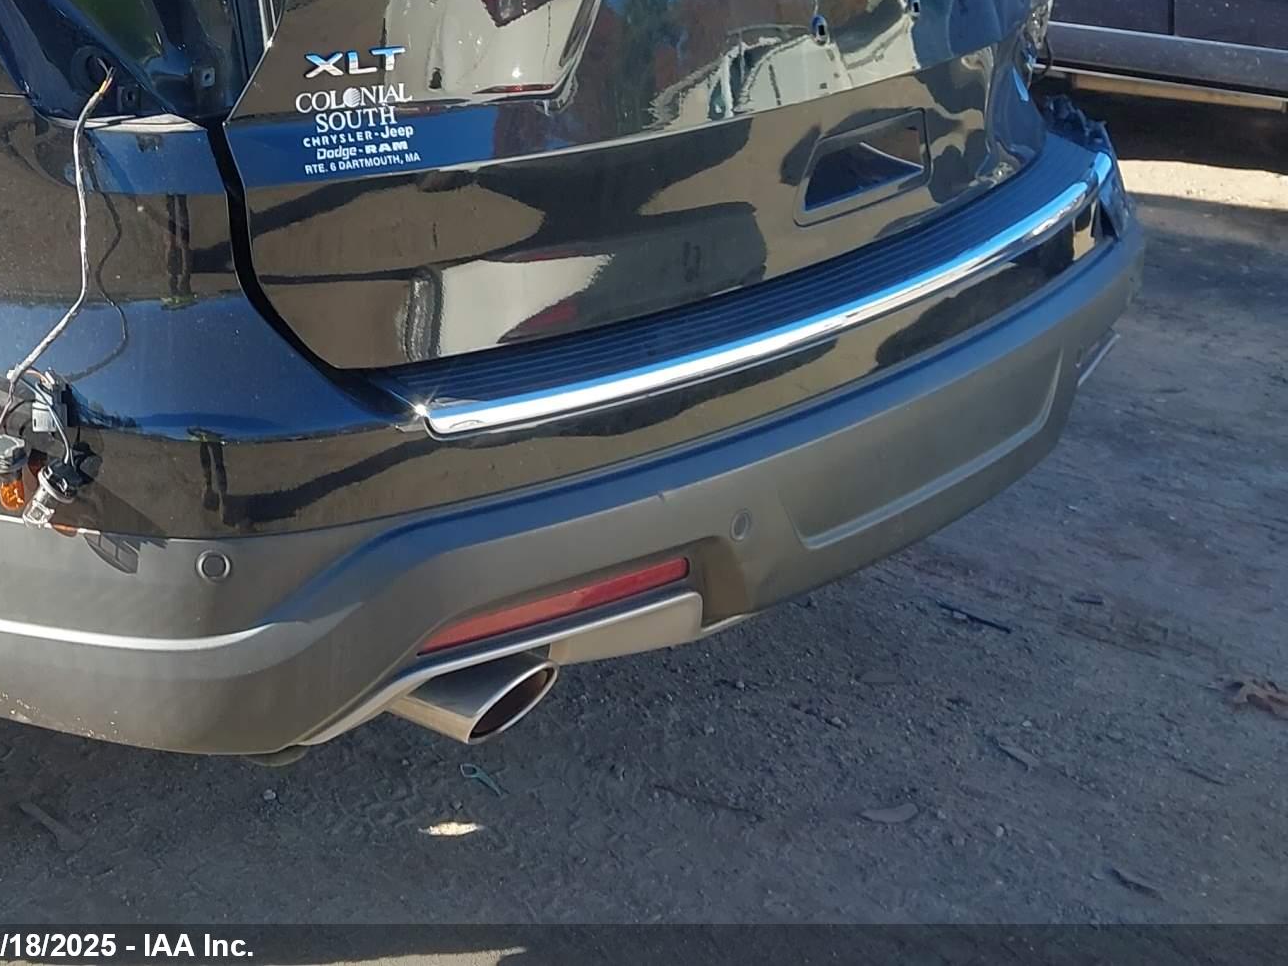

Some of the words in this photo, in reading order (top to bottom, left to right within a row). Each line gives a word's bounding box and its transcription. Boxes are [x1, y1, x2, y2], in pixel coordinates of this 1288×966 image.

[305, 46, 406, 78] XLT
[295, 83, 413, 113] COLONIAL
[315, 105, 398, 133] SOUTH
[305, 164, 328, 174] RTE.
[338, 154, 404, 171] DARTMOUTH,
[405, 152, 421, 162] MA
